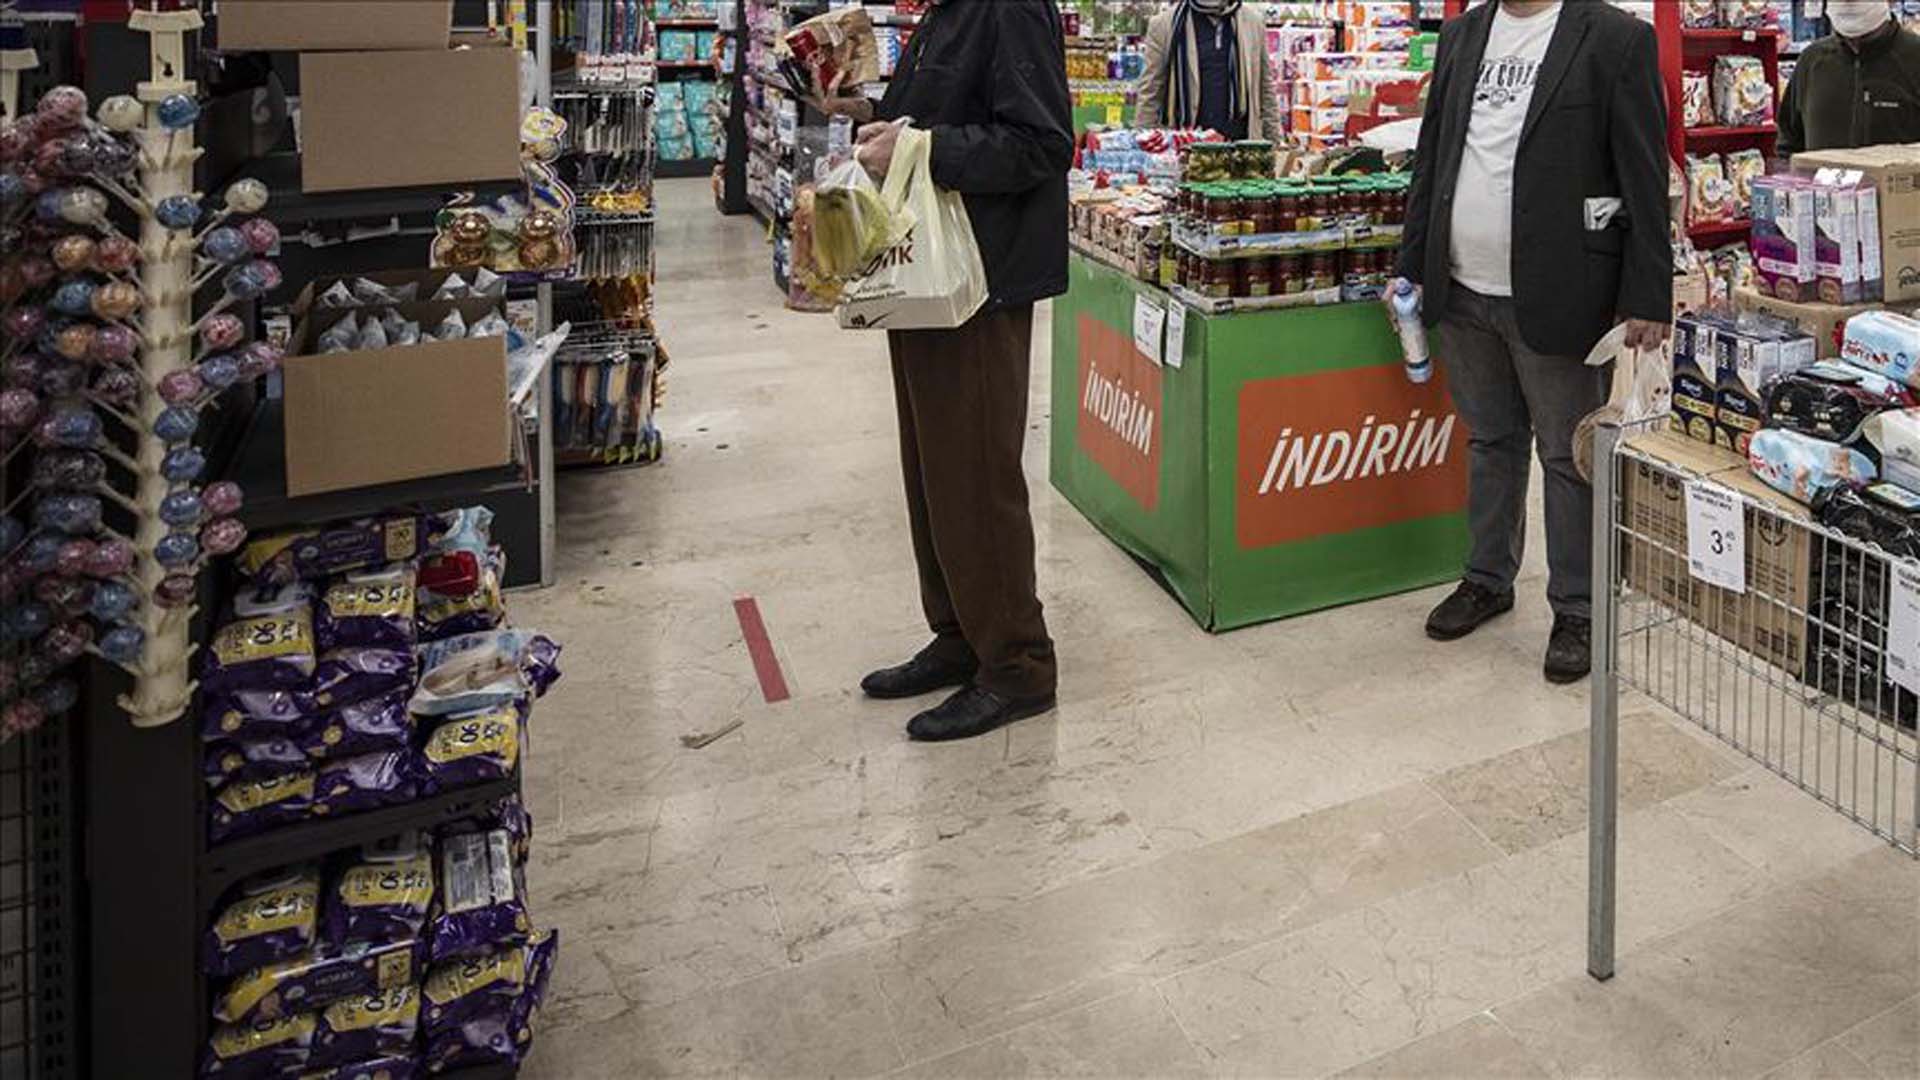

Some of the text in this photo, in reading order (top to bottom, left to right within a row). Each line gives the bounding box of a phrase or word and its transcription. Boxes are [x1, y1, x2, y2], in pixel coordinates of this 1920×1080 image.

[1083, 360, 1154, 455] İNDİRİM
[1257, 408, 1457, 495] İNDİRİM
[1710, 530, 1724, 555] 3
[459, 721, 480, 743] 90
